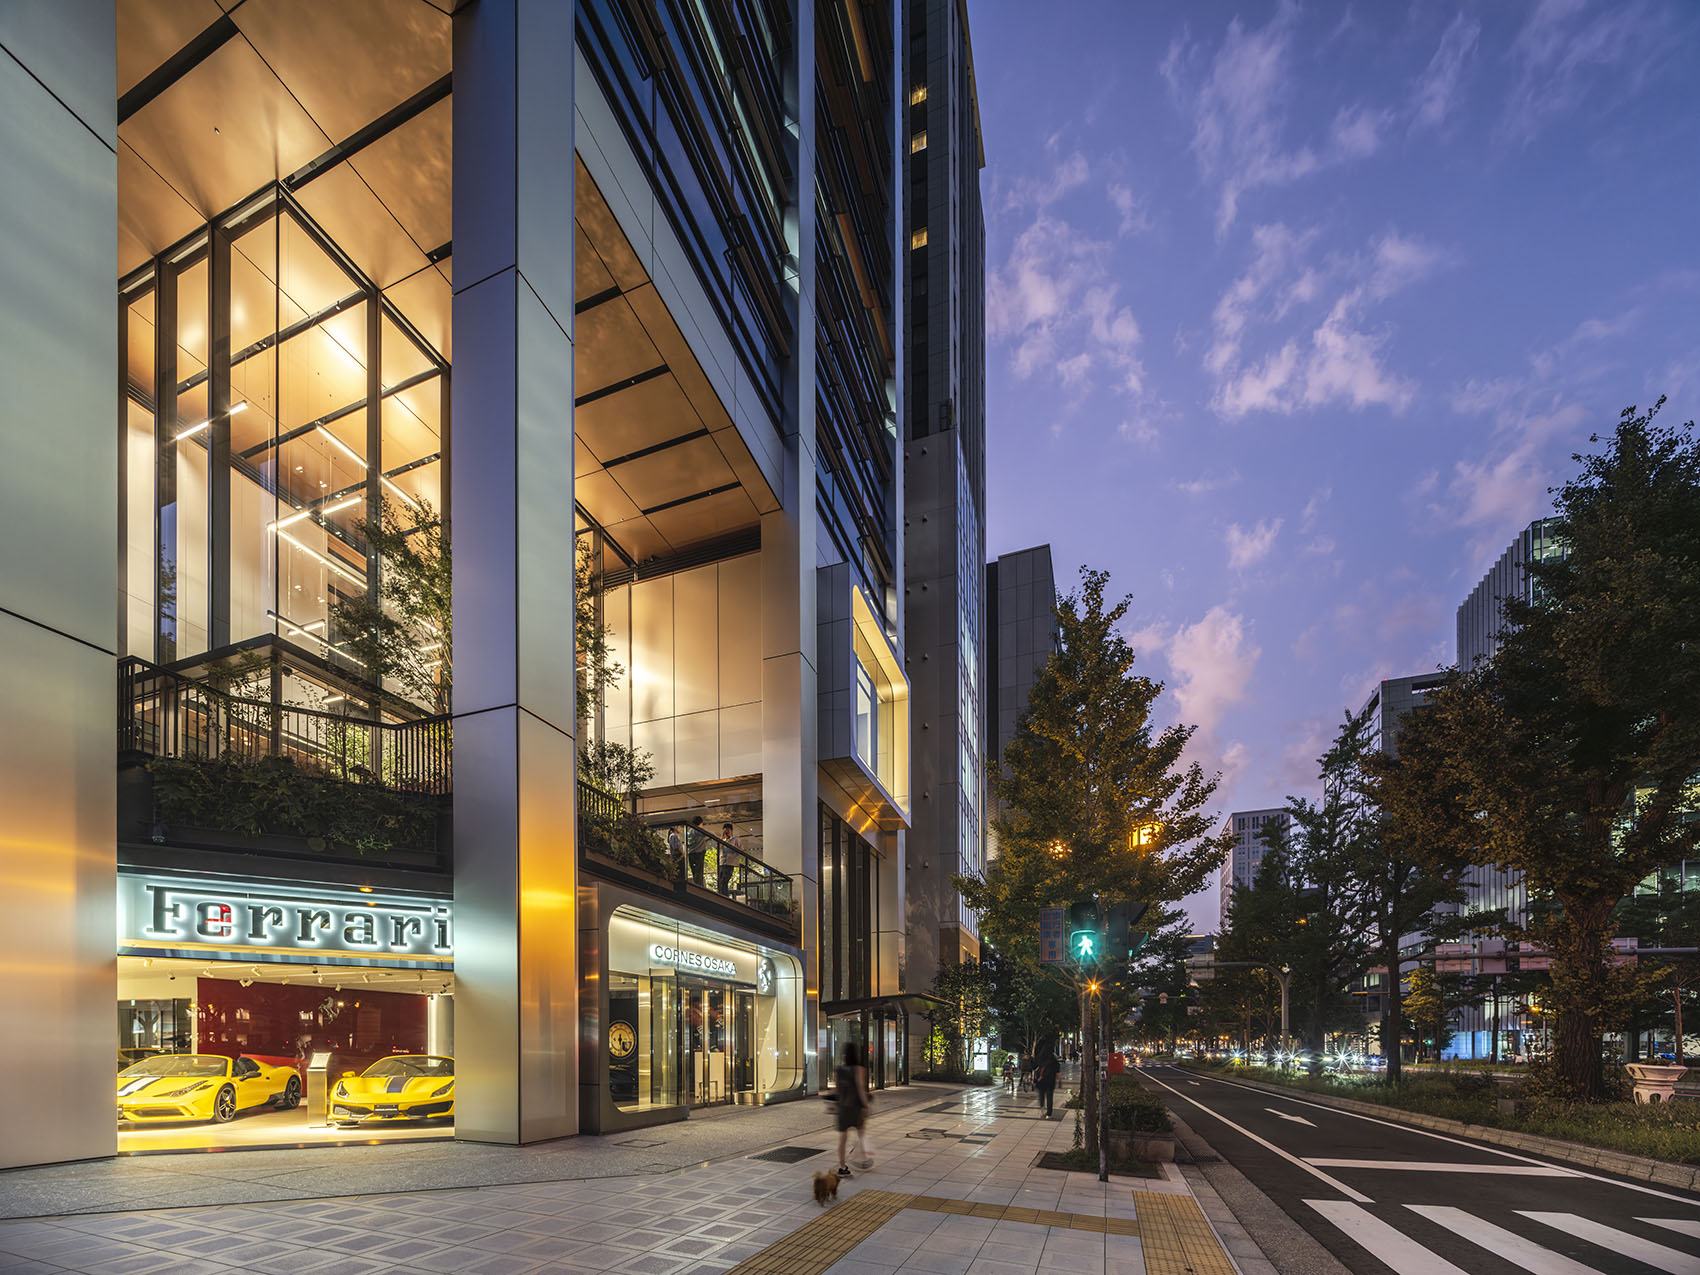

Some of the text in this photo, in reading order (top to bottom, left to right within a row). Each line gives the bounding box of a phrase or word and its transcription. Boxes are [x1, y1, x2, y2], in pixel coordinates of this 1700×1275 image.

[145, 885, 451, 949] Ferrari
[655, 945, 737, 974] CORNES OSAKA
